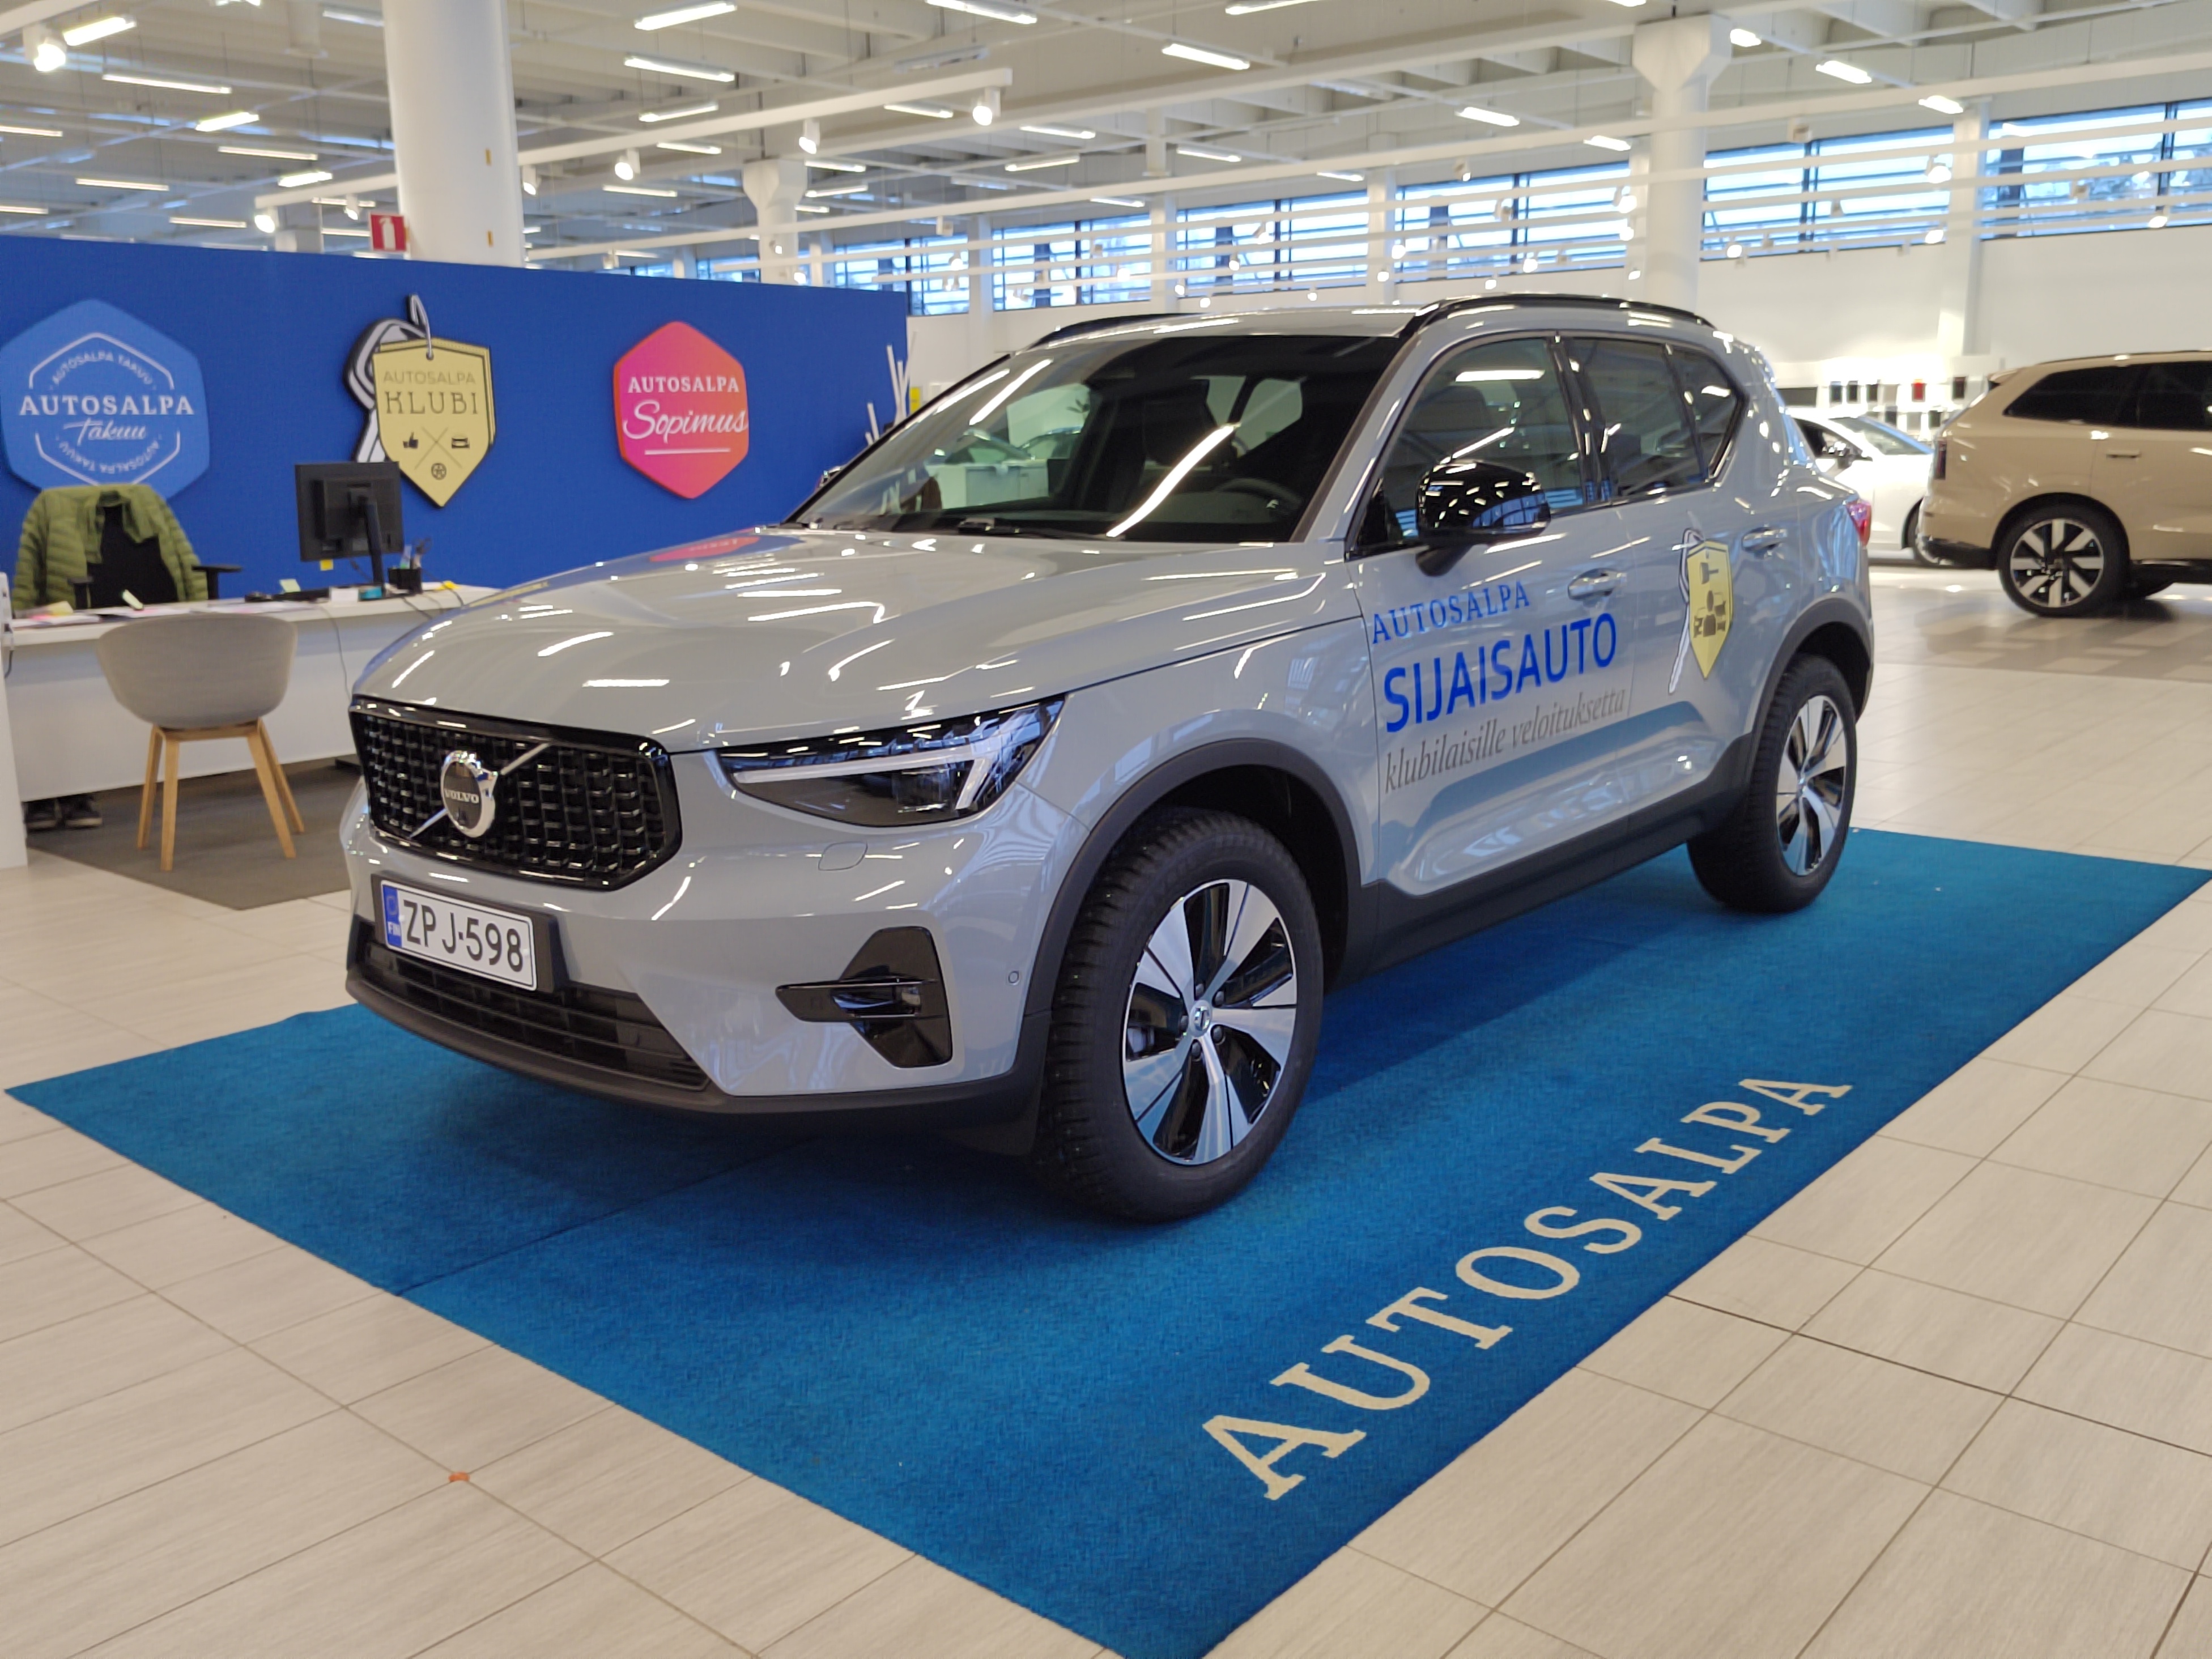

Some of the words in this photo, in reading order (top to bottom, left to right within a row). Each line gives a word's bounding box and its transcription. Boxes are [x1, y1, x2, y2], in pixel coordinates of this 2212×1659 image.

[382, 370, 476, 385] AUTOSALPA
[628, 376, 739, 393] AUTOSALPA
[19, 395, 194, 415] AUTOSALPA
[384, 391, 478, 415] KLUBI
[623, 399, 748, 444] Sopimus
[63, 417, 147, 446] Takuu
[1372, 580, 1530, 644] AUTOSALPA
[1384, 612, 1617, 733] SIJAISAUTO
[1385, 718, 1507, 794] klubilaisille
[1511, 688, 1626, 749] veloituksetta
[443, 788, 479, 803] VOLVO
[403, 899, 524, 972] ZPJ-598
[1201, 1077, 1853, 1500] AUTOSALPA
